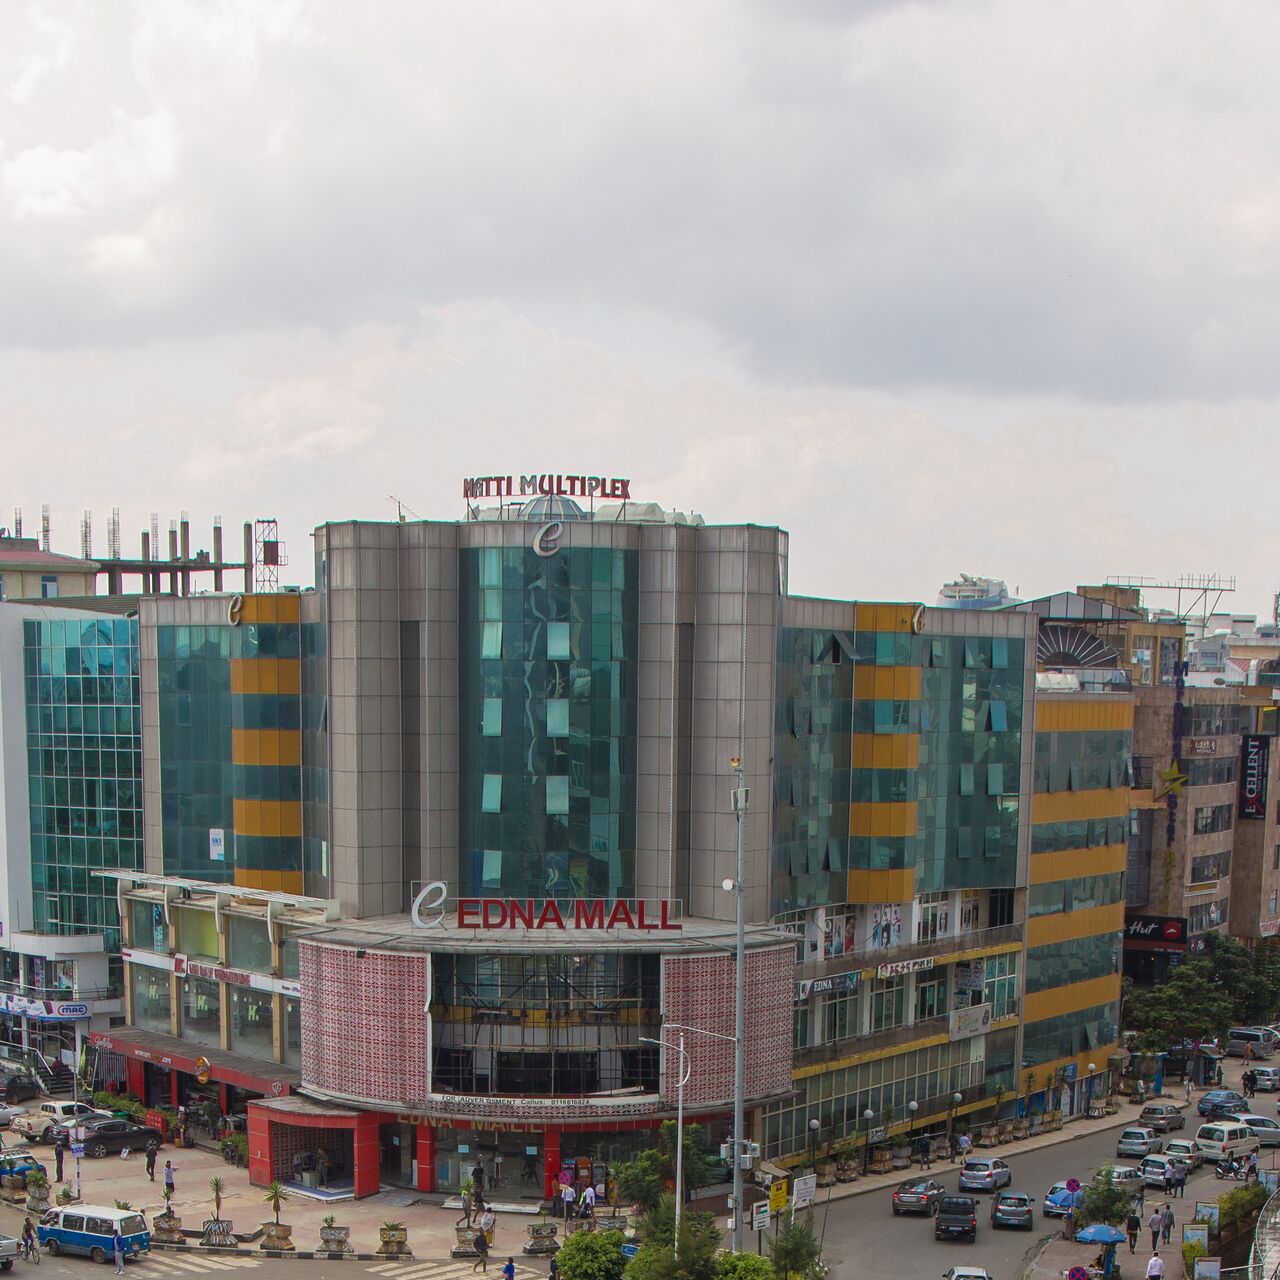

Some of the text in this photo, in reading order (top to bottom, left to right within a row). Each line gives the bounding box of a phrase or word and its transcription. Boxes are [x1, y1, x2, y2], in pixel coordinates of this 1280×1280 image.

[463, 474, 631, 499] MATTI MULTIPLEX
[457, 899, 564, 929] EDNA
[575, 899, 682, 929] MALL
[1129, 920, 1159, 935] Hut
[813, 978, 832, 992] EDNA
[460, 1096, 516, 1106] ADVERTISMENT
